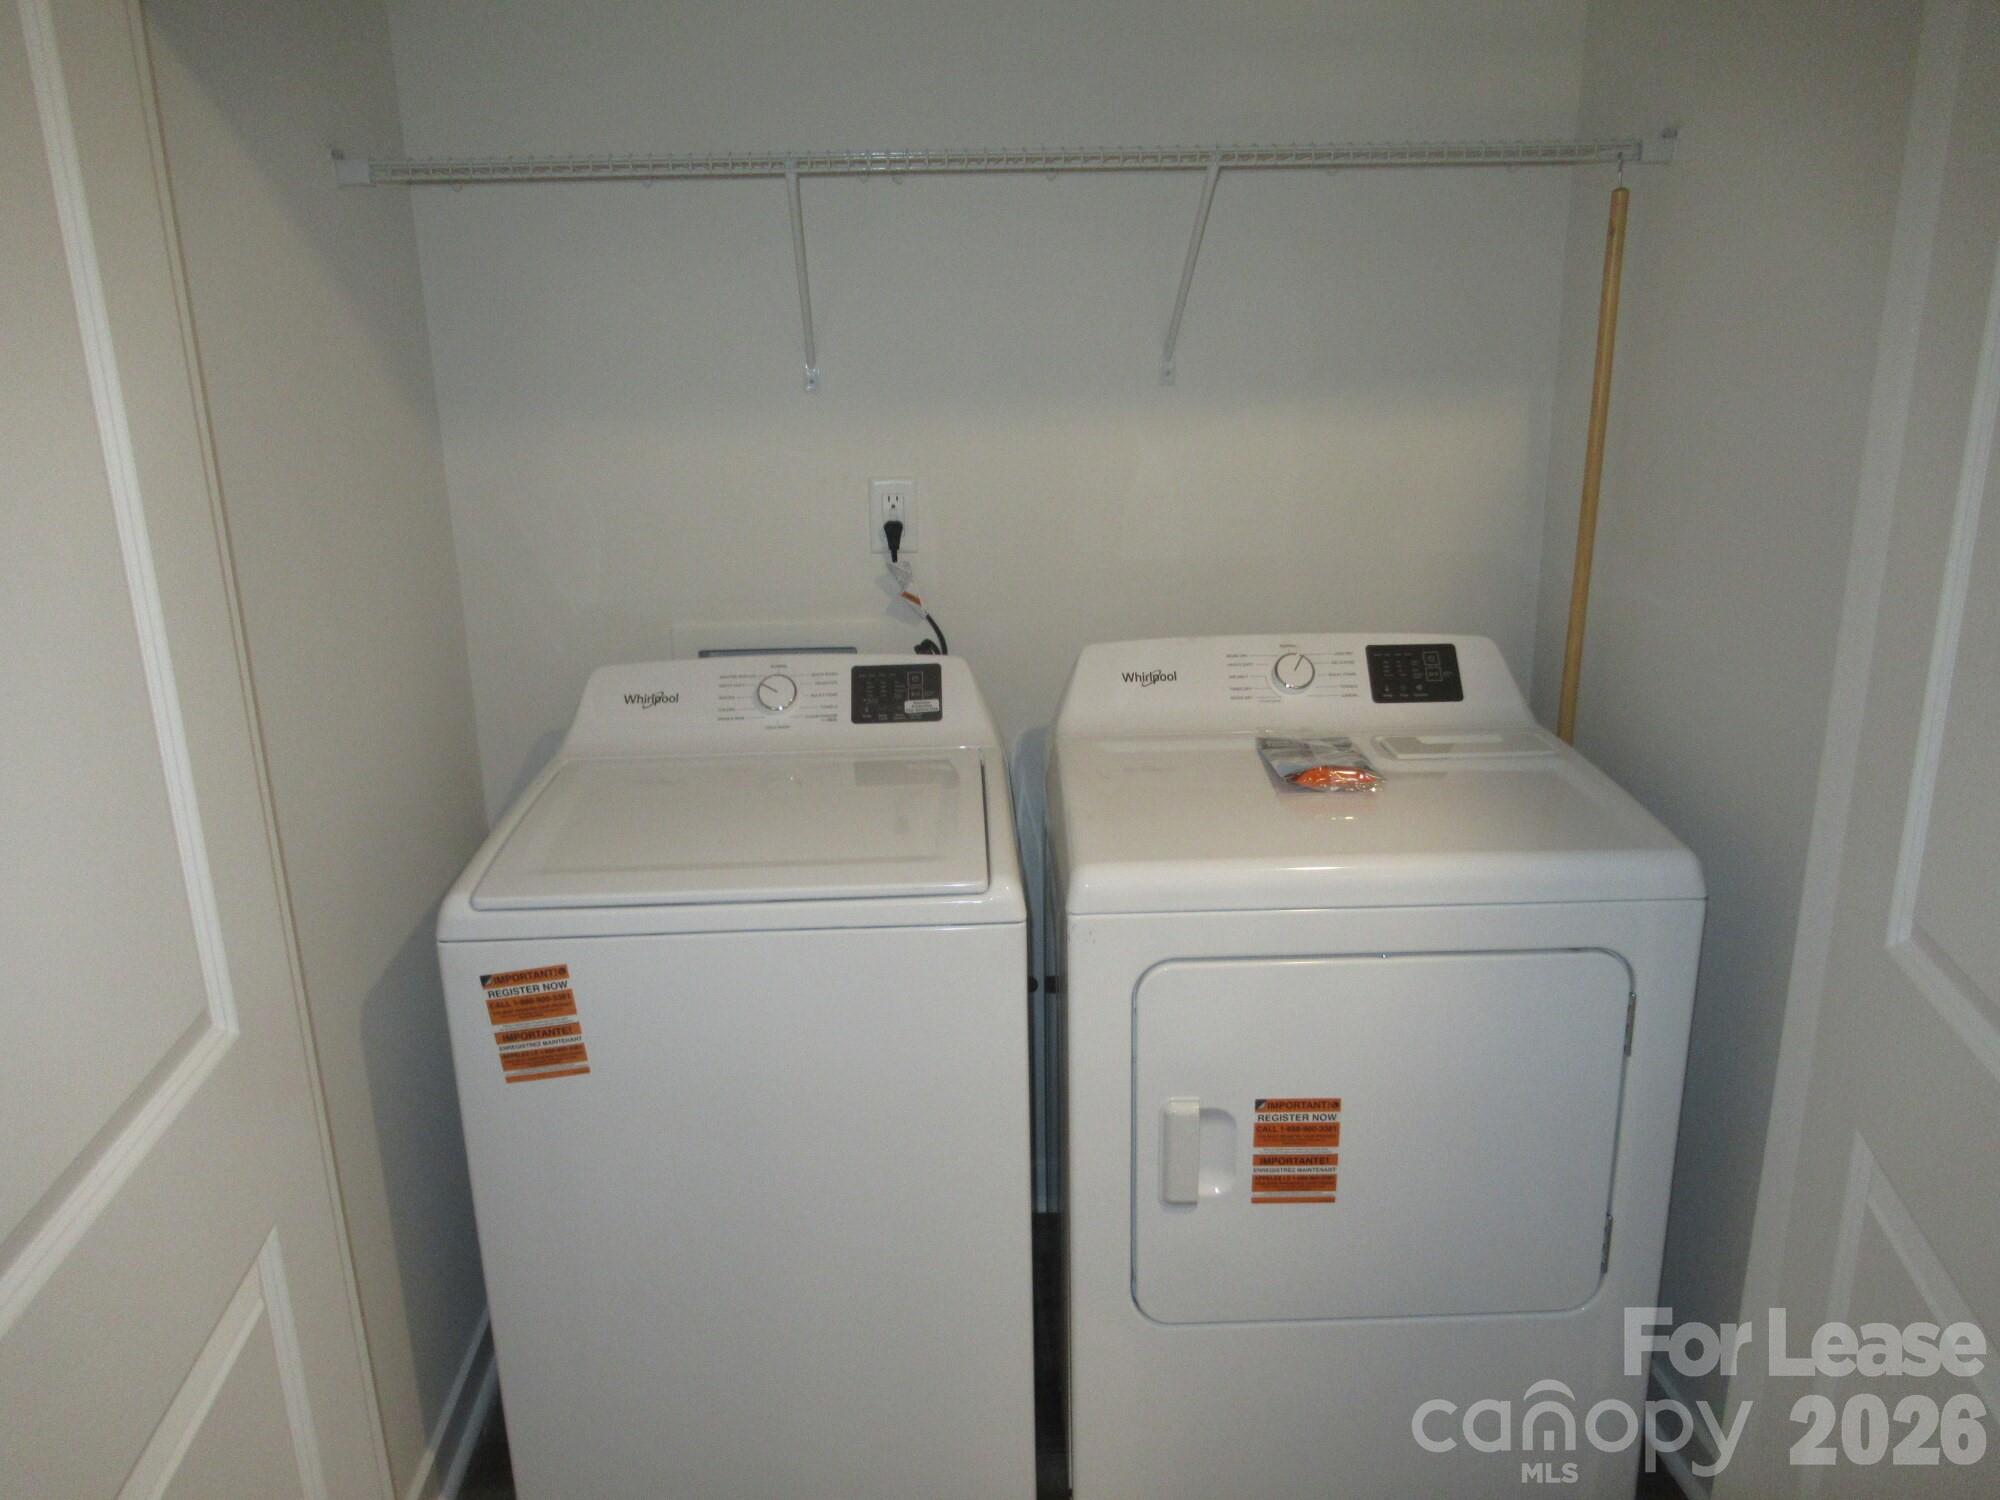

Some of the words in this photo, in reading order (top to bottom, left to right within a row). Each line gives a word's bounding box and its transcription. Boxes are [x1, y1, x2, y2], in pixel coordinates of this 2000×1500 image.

[1121, 669, 1177, 687] Whirlpool
[623, 691, 680, 710] Whirlpool
[487, 986, 541, 999] REGISTER
[542, 980, 568, 992] NOW
[1257, 1113, 1309, 1122] REGISTER
[1312, 1113, 1337, 1121] NOW
[1255, 1125, 1277, 1133] CALL
